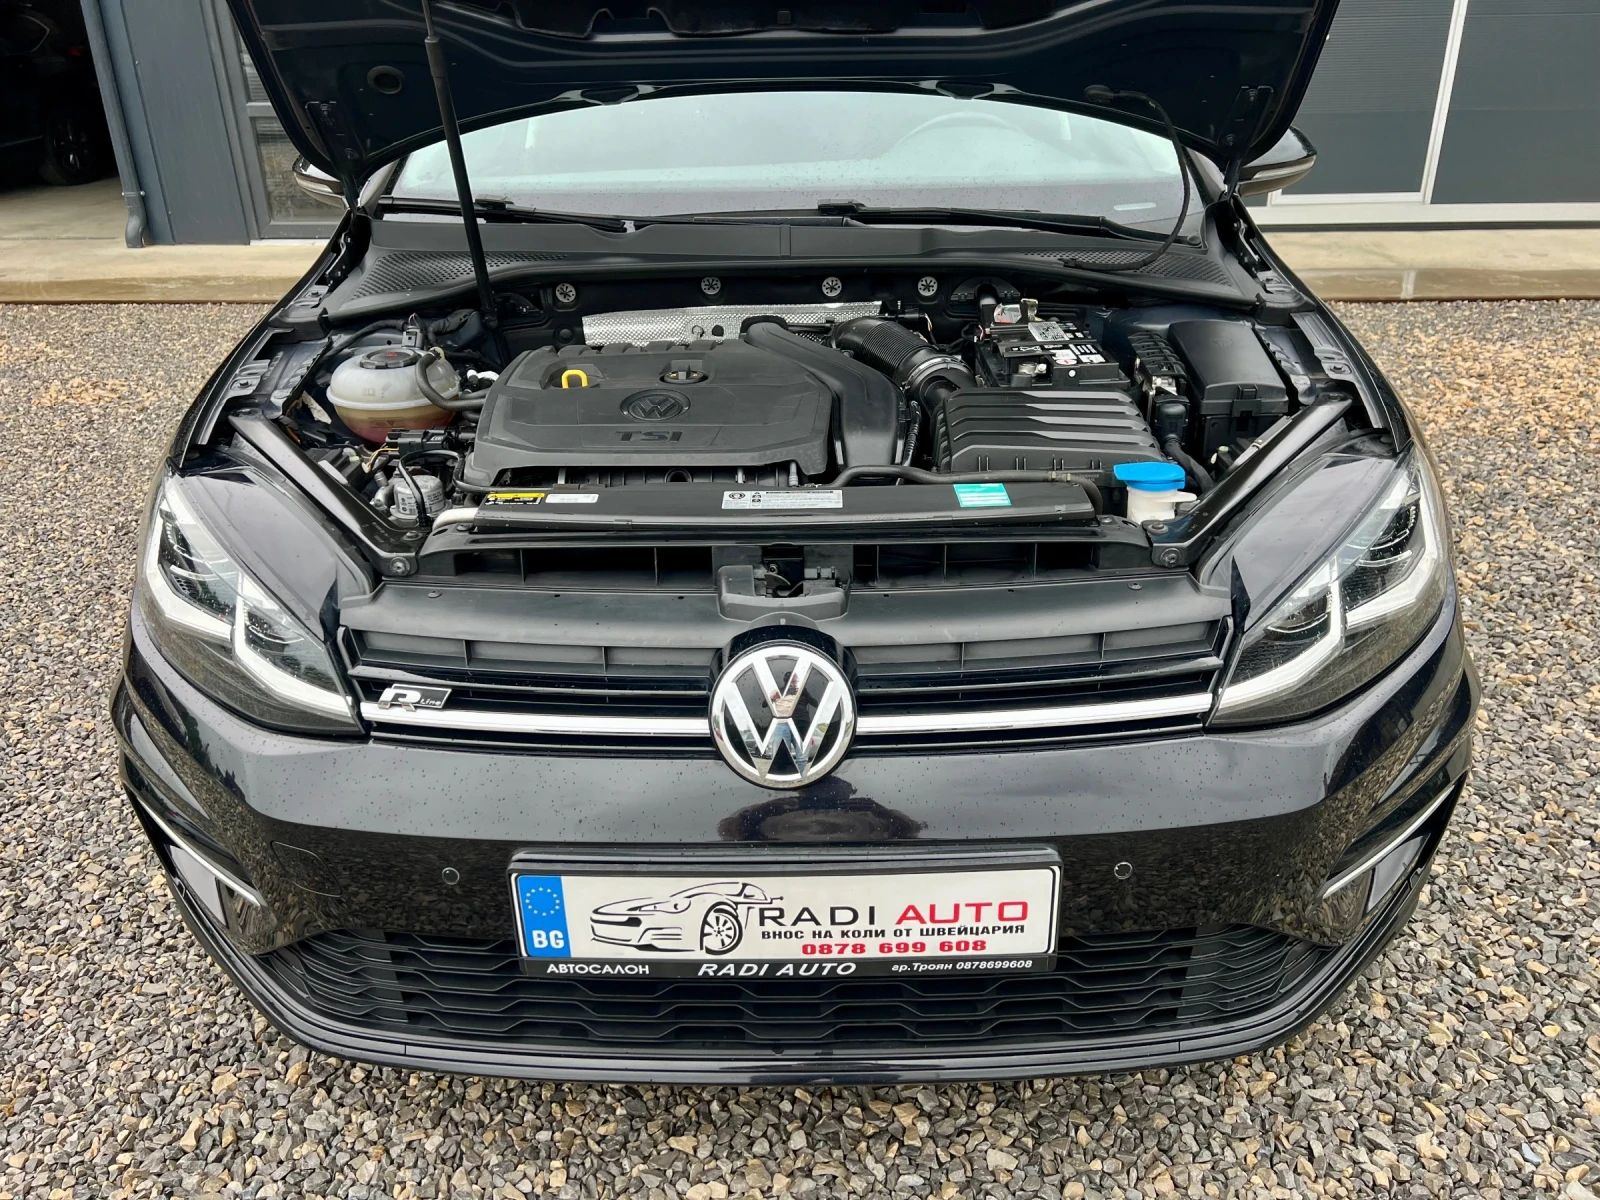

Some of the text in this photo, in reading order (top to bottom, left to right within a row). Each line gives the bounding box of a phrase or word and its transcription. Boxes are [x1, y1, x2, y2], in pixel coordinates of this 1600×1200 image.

[615, 430, 683, 442] TSI
[378, 687, 421, 712] R
[711, 646, 854, 788] VW
[758, 901, 1028, 927] RADI AUTO
[761, 924, 1025, 939] ВНОС НА КОЛИ ОТ ШВЕЙЦАРИЯ
[531, 930, 565, 949] BG
[801, 940, 987, 955] 0878 699 608
[546, 963, 650, 975] АВТОСАЛОН
[697, 962, 857, 977] RADI AUTO
[955, 960, 1033, 970] 0878699608
